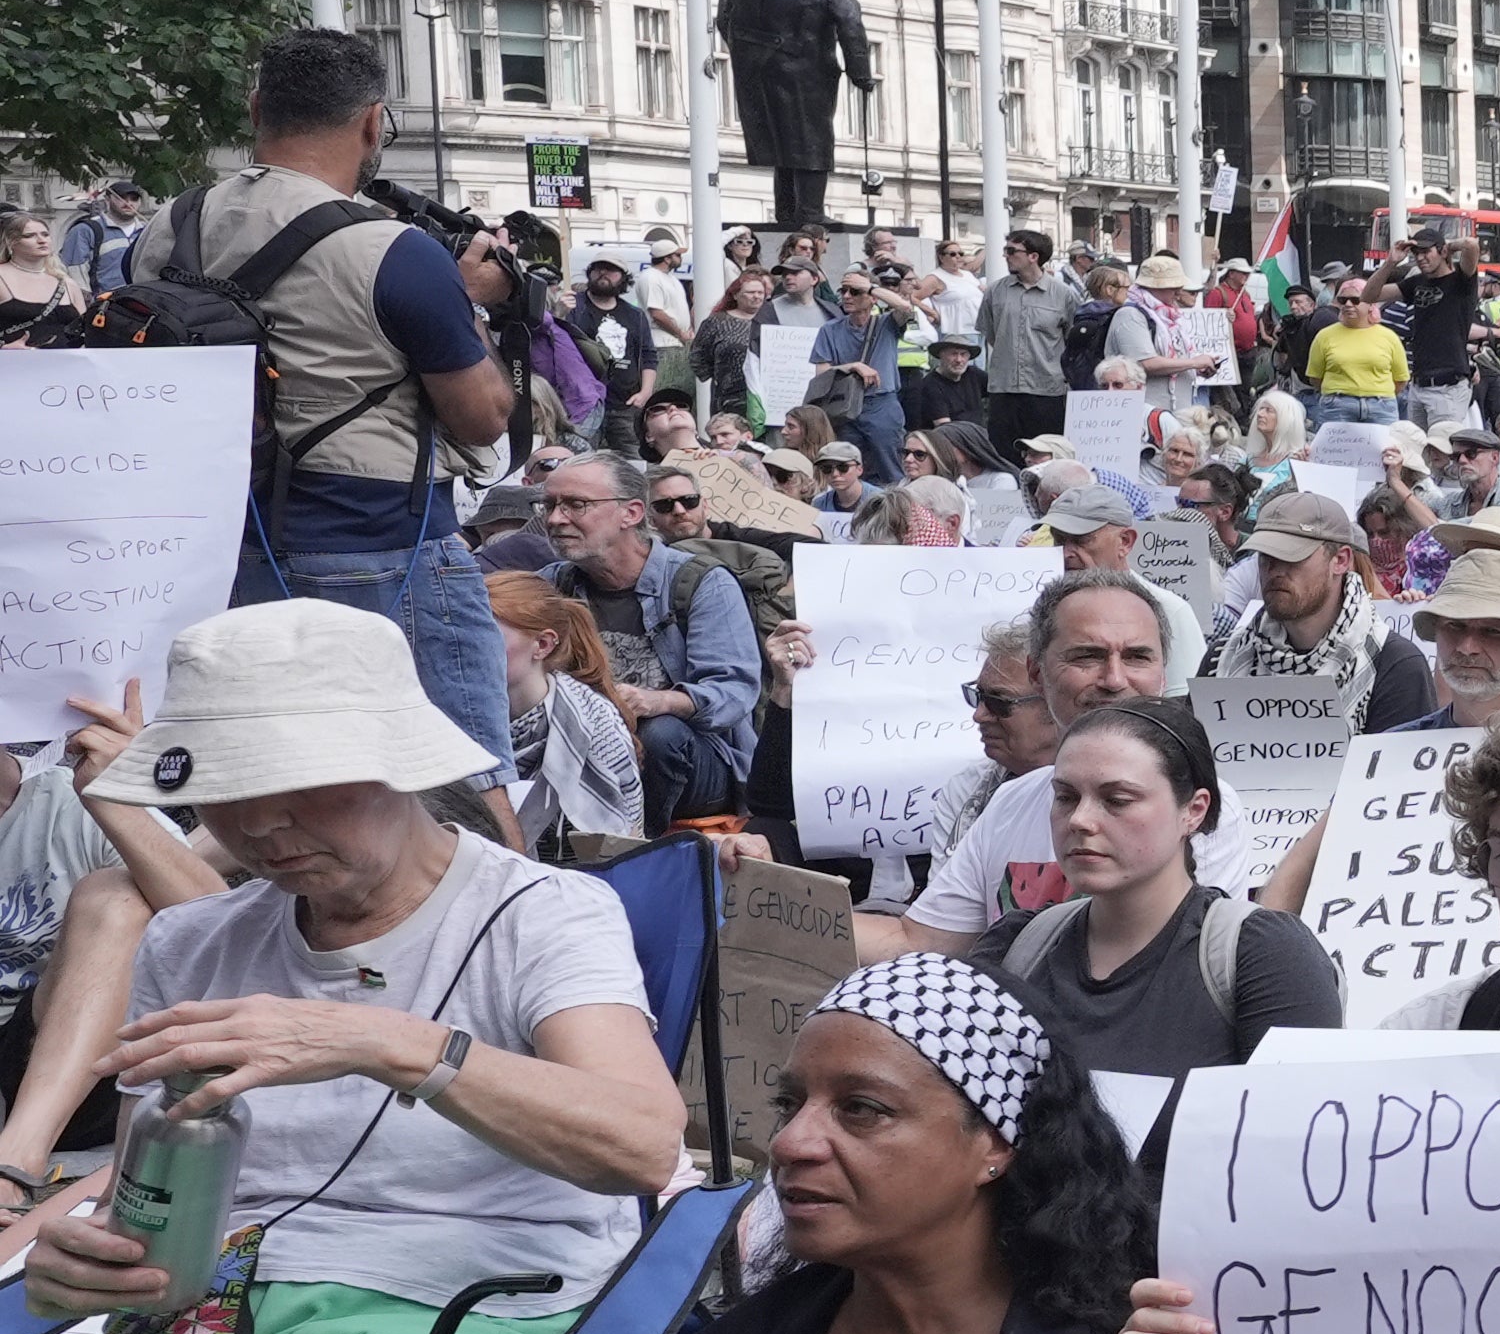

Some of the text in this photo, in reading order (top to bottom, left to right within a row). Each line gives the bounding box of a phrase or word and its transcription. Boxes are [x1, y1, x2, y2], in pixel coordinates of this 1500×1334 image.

[532, 144, 580, 156] FROM THE
[533, 155, 577, 166] RIVER TO
[534, 165, 574, 176] THE SEA
[534, 175, 584, 187] PALESTINE
[534, 186, 574, 197] WILL BE
[535, 196, 560, 207] FREE
[512, 359, 524, 396] SONY
[1142, 531, 1189, 555] Oppose
[1216, 698, 1341, 721] I OPPOSE
[1212, 740, 1346, 764] GENOCIDE
[157, 769, 181, 782] NOW
[1227, 1089, 1250, 1224] I
